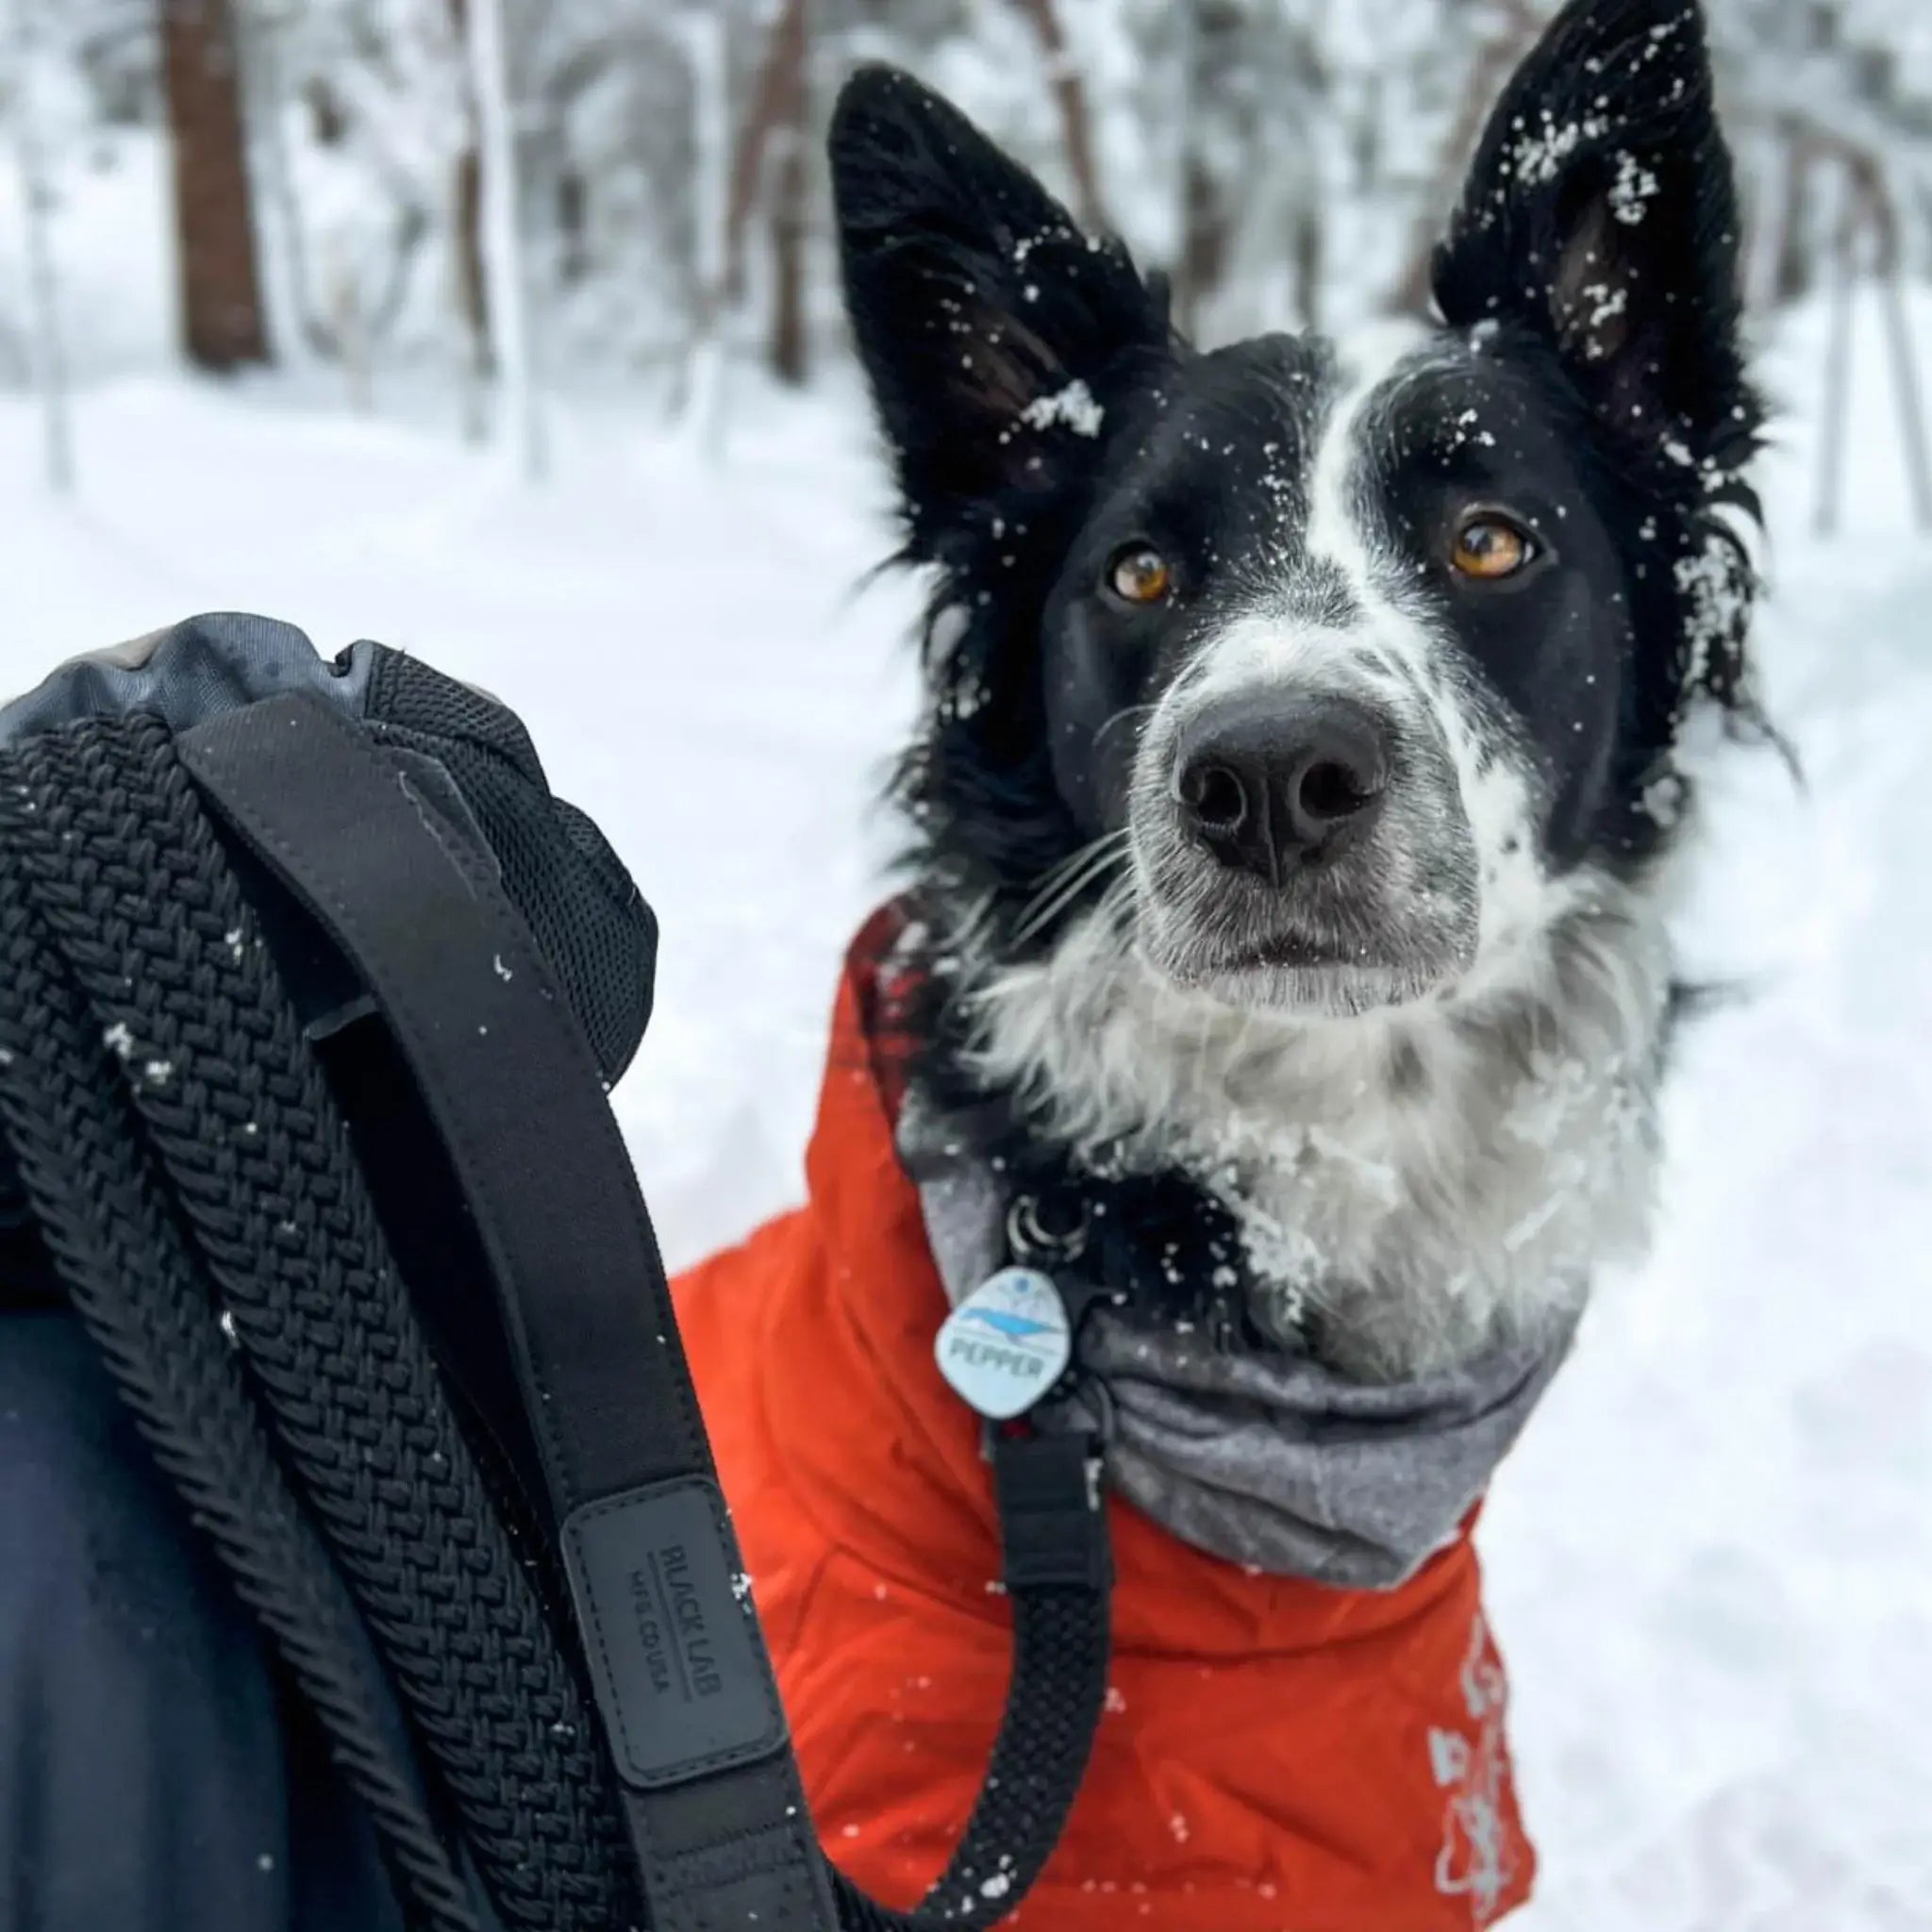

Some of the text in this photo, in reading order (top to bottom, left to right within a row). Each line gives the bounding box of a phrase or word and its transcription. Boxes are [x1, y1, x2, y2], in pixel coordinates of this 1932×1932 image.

[950, 1337, 1044, 1379] PEPPER
[660, 1544, 722, 1696] BLACK LAB
